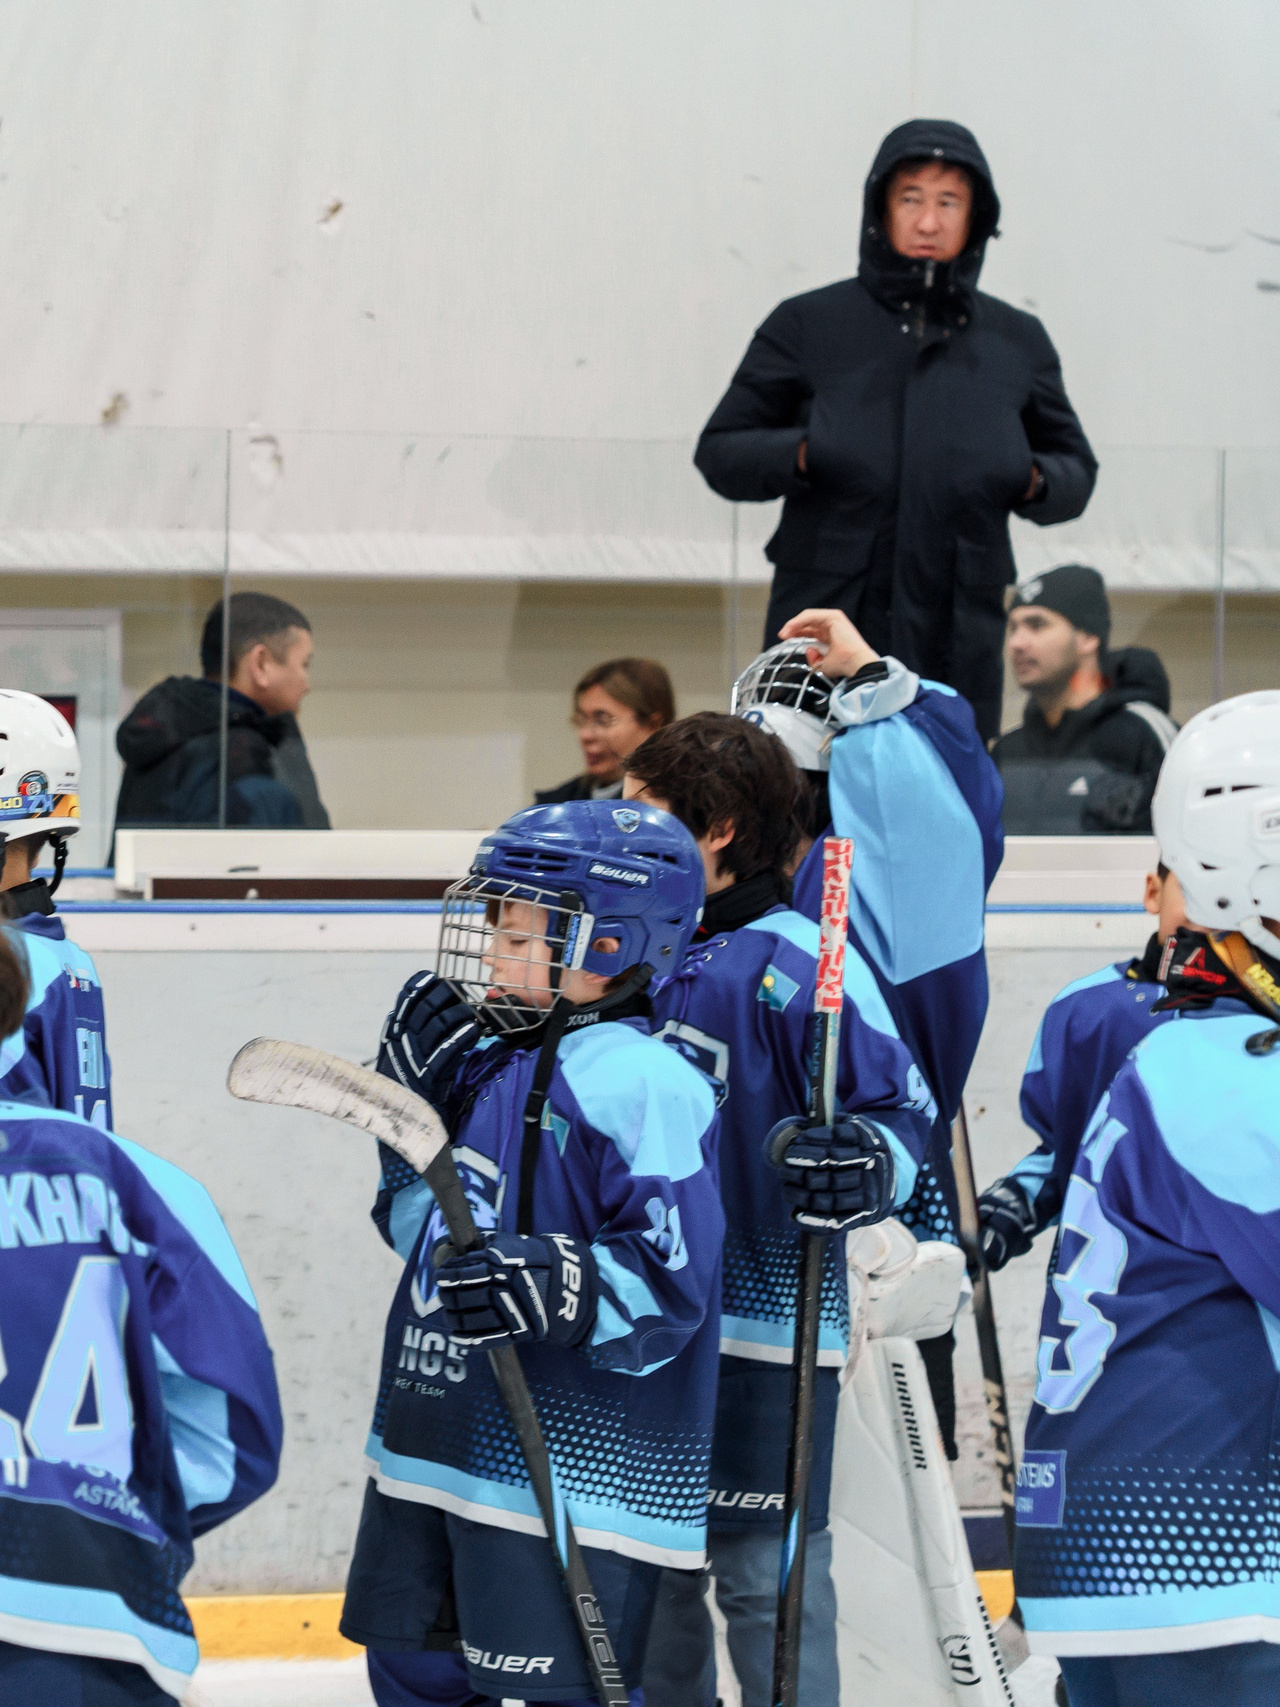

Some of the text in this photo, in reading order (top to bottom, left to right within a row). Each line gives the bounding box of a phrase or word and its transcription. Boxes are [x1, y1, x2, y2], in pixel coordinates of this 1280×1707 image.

[27, 794, 54, 813] KZ
[589, 863, 651, 885] BAUER
[551, 1233, 583, 1322] UER
[414, 1381, 446, 1399] TEAM
[892, 1362, 927, 1470] WARRIOR
